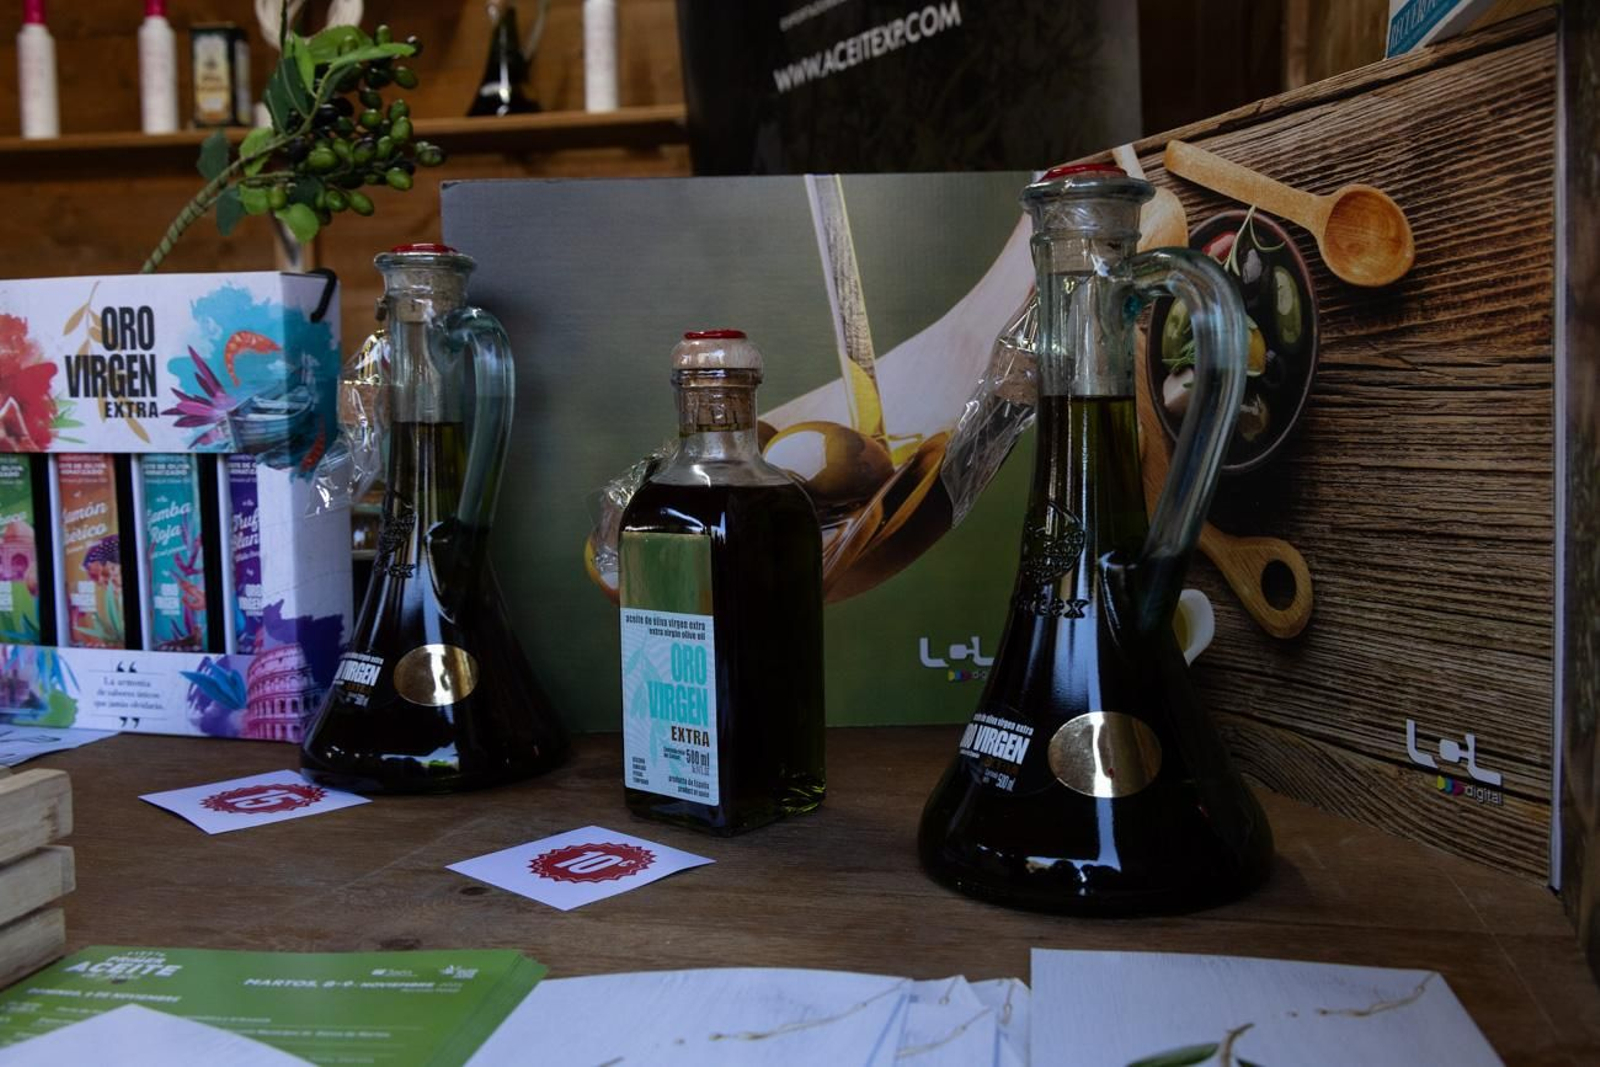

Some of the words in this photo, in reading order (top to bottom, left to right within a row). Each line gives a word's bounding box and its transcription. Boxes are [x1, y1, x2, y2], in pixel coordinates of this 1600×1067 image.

[101, 306, 154, 351] ORO
[65, 354, 157, 398] VIRGEN
[105, 402, 159, 420] EXTRA
[670, 641, 708, 686] ORO
[647, 680, 709, 729] VIRGEN
[671, 726, 710, 748] EXTRA
[973, 724, 1031, 767] VIRGEN
[63, 960, 184, 978] ACEITE
